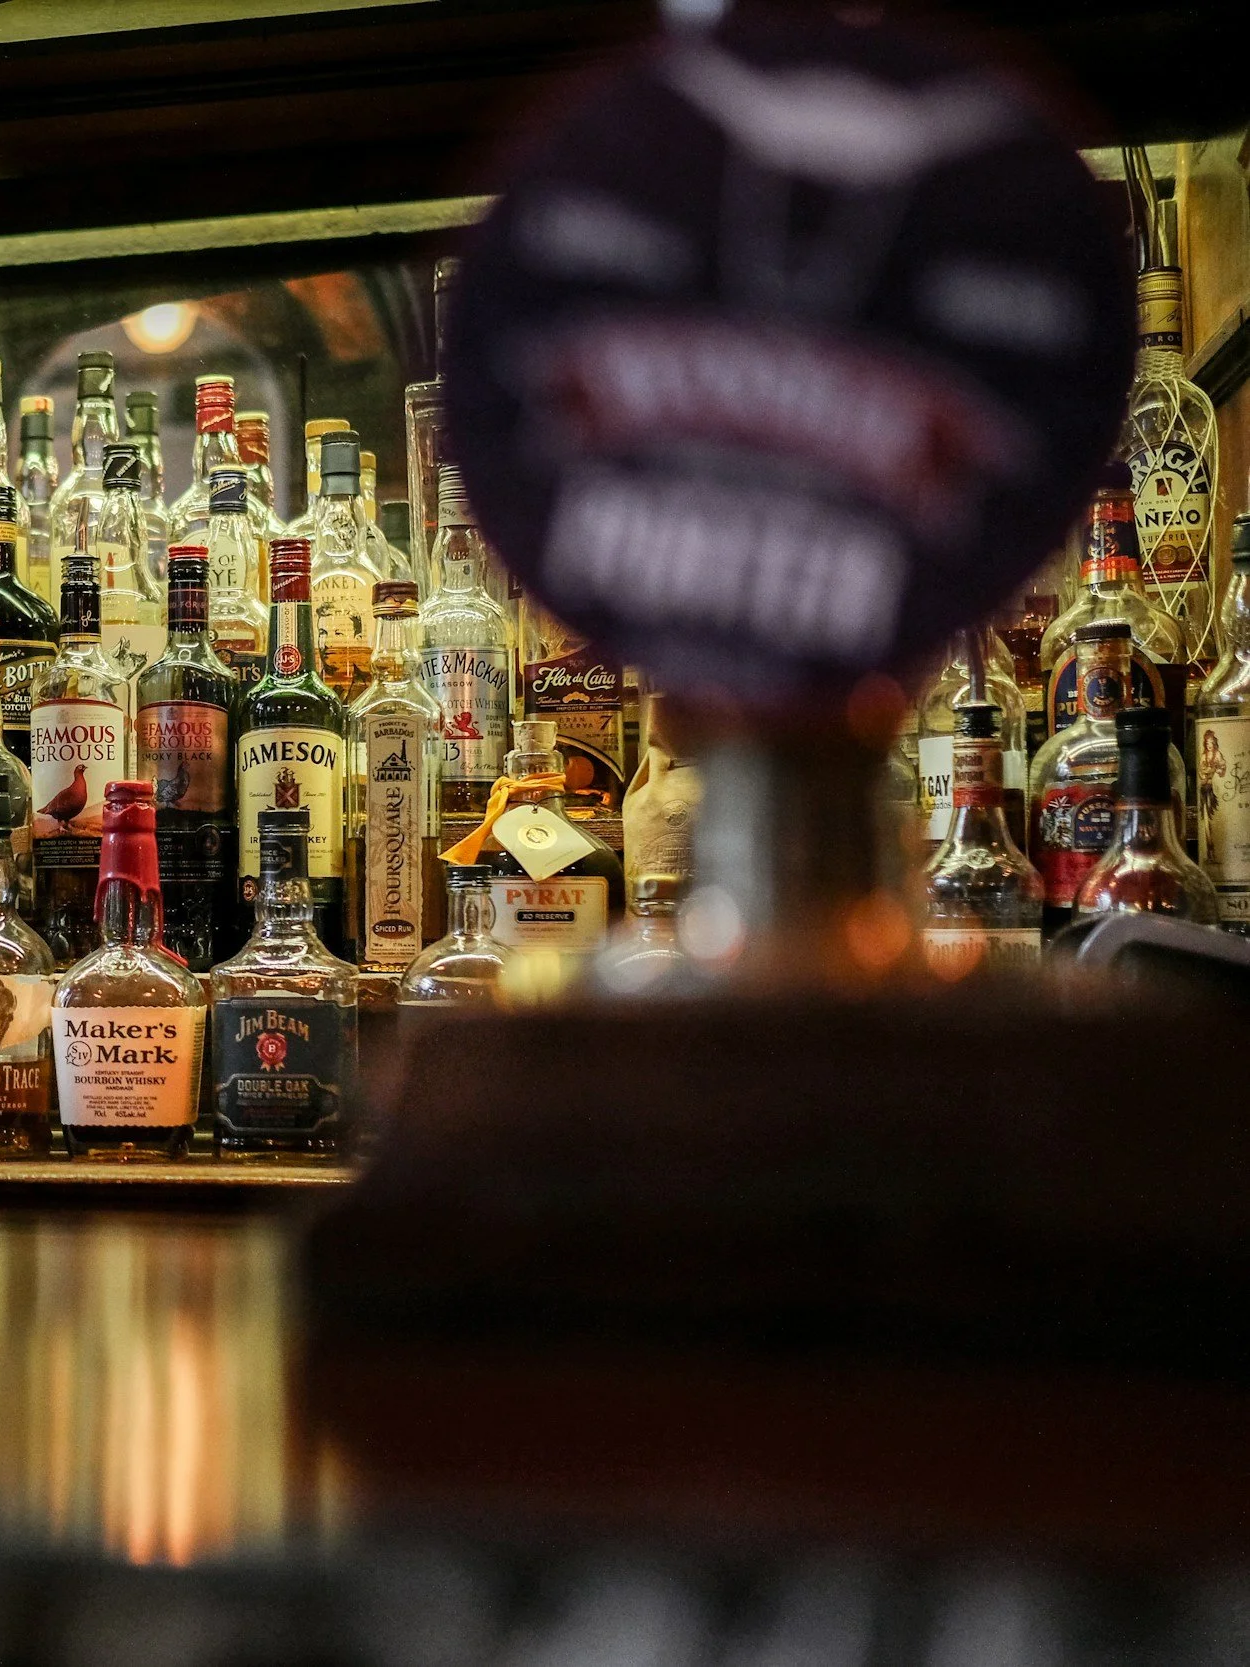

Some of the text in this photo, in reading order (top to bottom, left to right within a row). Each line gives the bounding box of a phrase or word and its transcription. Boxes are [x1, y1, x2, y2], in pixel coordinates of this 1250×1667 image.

[3, 660, 51, 688] BOTT
[454, 651, 508, 691] MACKAY
[532, 664, 617, 693] Flor de Caña
[430, 681, 473, 689] GLASGOW
[1, 703, 26, 711] COTCH
[148, 722, 212, 736] FAMOUS
[599, 715, 614, 731] 7
[36, 725, 115, 746] FAMOUS
[148, 736, 212, 749] GROUSE
[373, 728, 415, 739] BARBADOS
[36, 744, 116, 762] GROUSE
[142, 752, 212, 762] SMOKY BLACK
[241, 741, 337, 772] JAMESON
[927, 774, 951, 797] GAY
[384, 786, 405, 916] FOURSQUARE
[505, 888, 585, 905] PYRAT
[375, 924, 396, 932] SPICED
[64, 1019, 177, 1039] Maker's
[235, 1009, 310, 1042] JIM BEAM
[95, 1045, 177, 1064] Mark
[2, 1065, 40, 1091] TRACE
[74, 1075, 167, 1085] BOURBON WHISKY
[237, 1079, 310, 1092] DOUBLE OAK
